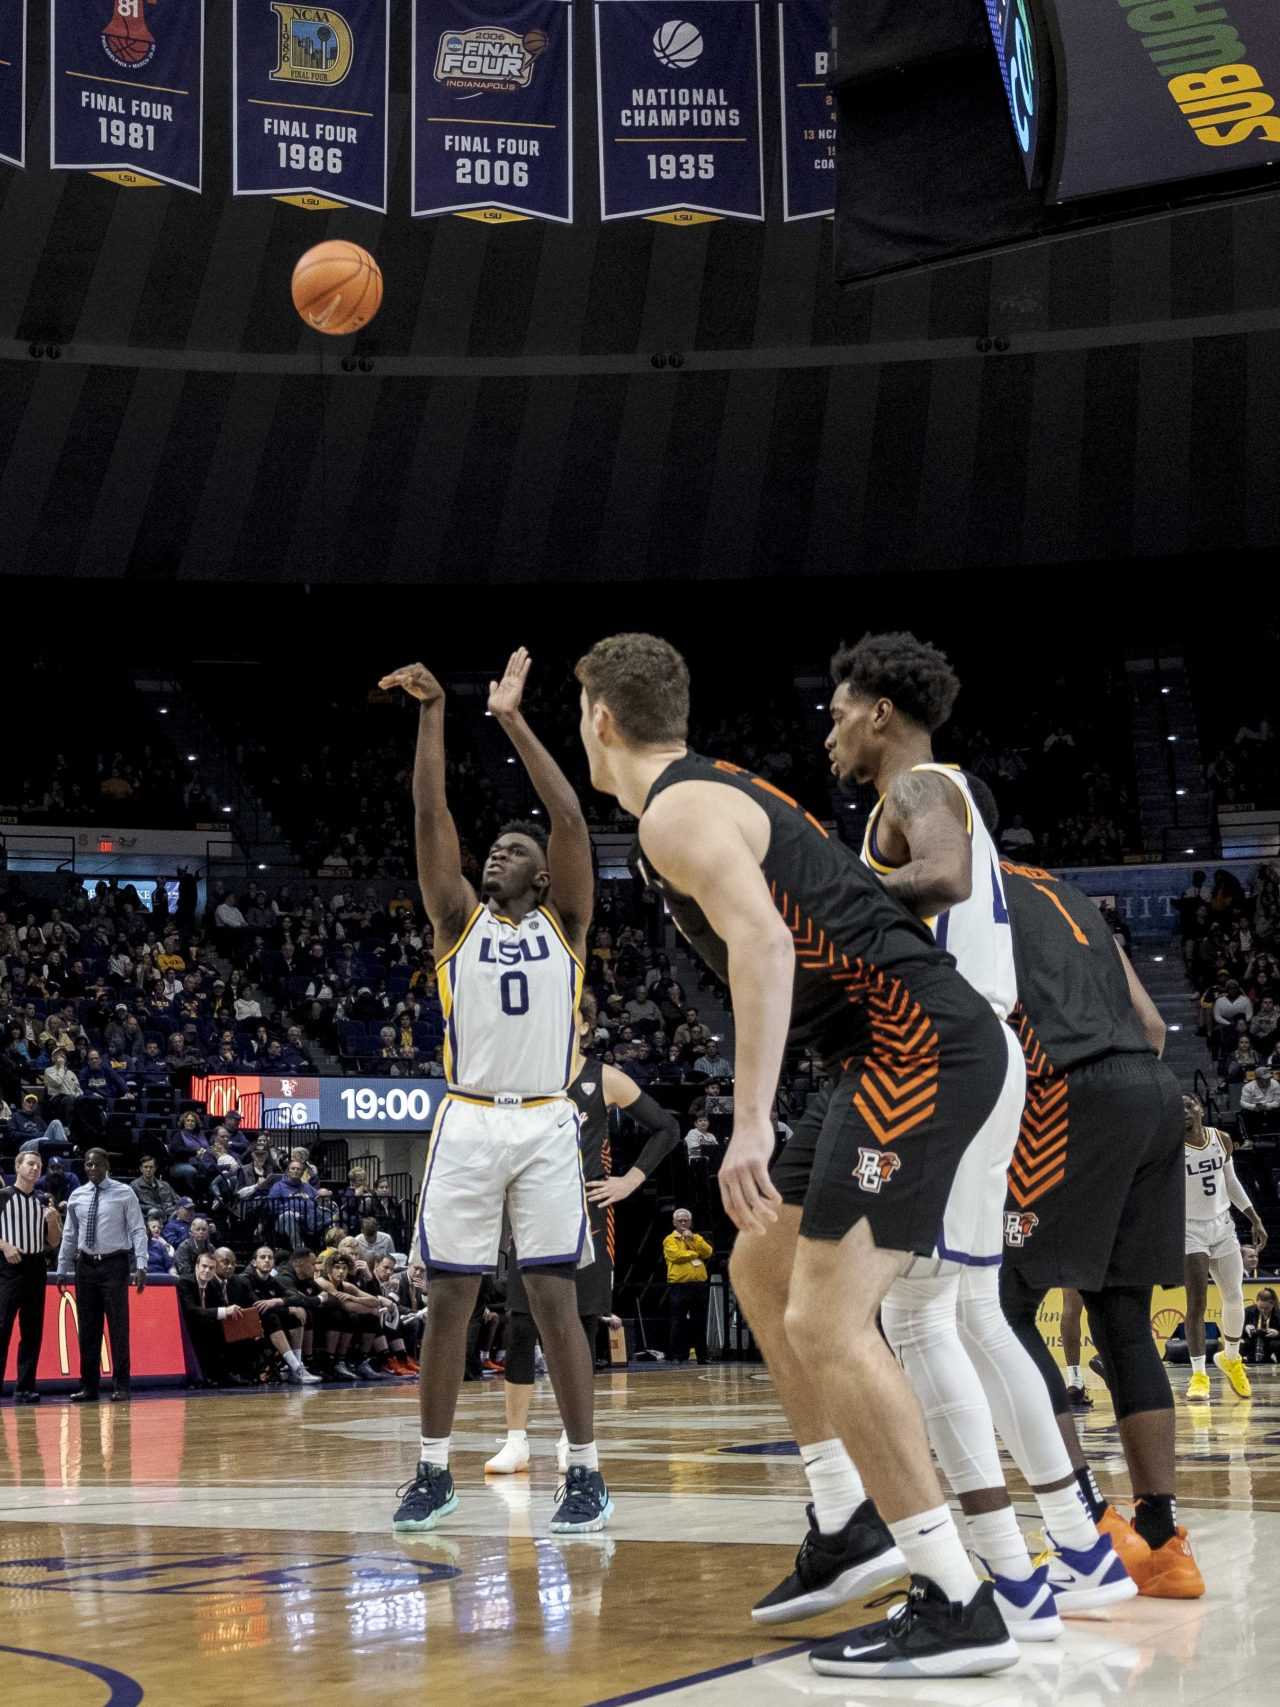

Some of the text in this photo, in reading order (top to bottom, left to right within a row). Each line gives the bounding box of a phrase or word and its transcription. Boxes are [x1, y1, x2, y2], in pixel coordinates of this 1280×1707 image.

[292, 8, 329, 23] NCAA
[464, 41, 524, 58] FINAL
[443, 54, 523, 77] FOUR
[446, 80, 517, 91] INDIANAPOLIS
[631, 88, 728, 106] NATIONAL
[81, 91, 175, 122] FINAL FOUR
[620, 109, 740, 127] CHAMPIONS
[98, 117, 155, 152] 1981
[264, 118, 358, 144] FINAL FOUR
[445, 135, 541, 157] FINAL FOUR
[278, 142, 343, 174] 1986
[647, 154, 715, 180] 1935
[456, 158, 529, 188] 2006
[479, 936, 550, 966] LSU
[500, 972, 529, 1016] 0
[341, 1088, 431, 1121] 19:00
[497, 1097, 519, 1105] LSU
[1186, 1156, 1223, 1176] LSU
[1202, 1175, 1217, 1197] 5
